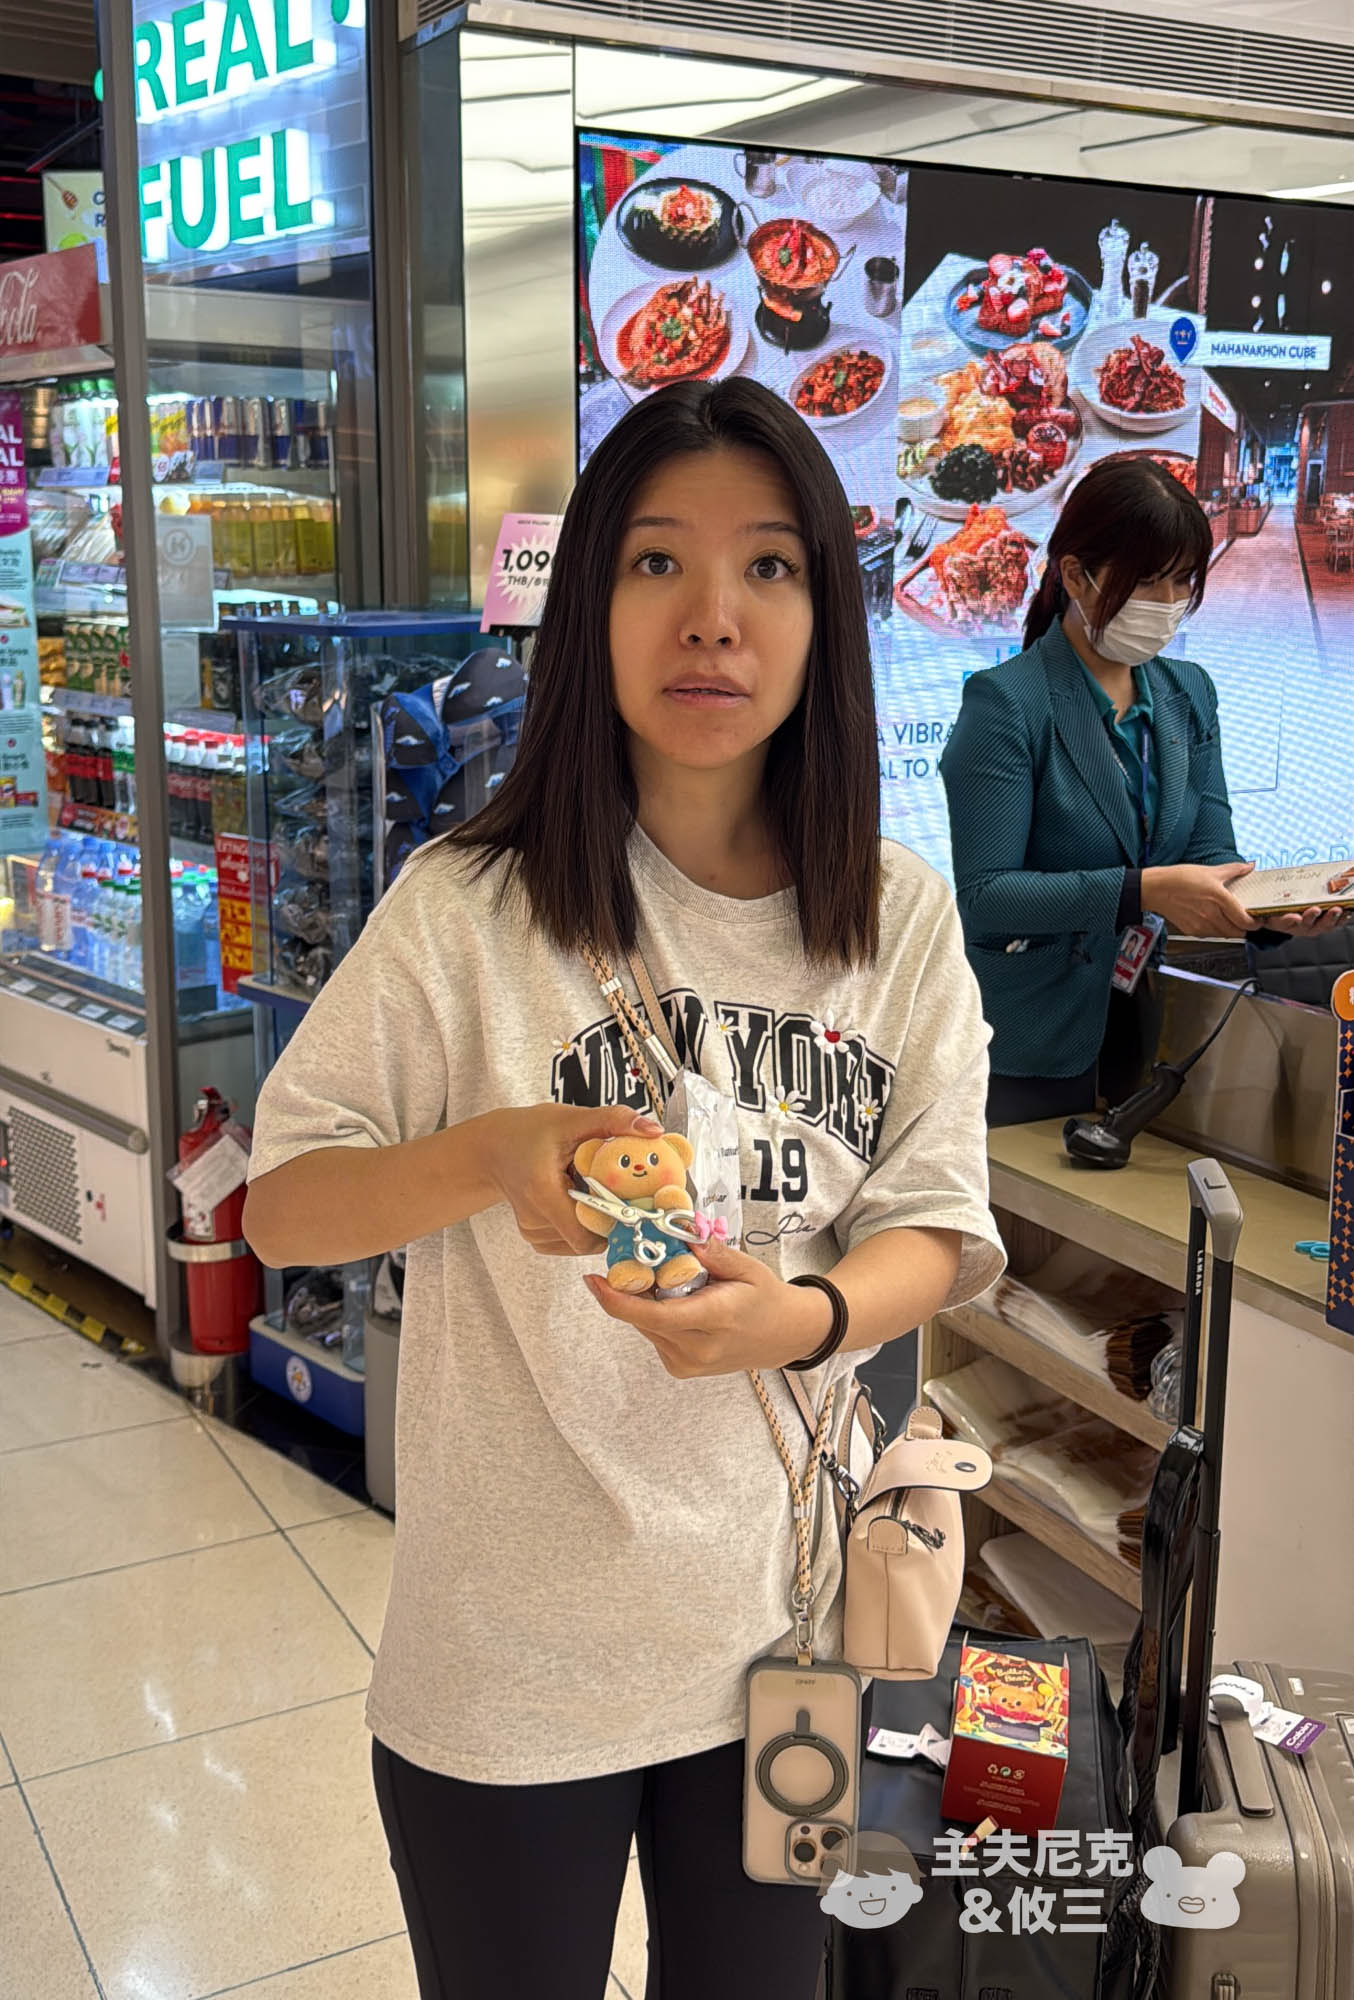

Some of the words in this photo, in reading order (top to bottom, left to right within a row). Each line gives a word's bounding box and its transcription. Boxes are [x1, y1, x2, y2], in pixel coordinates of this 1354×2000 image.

[136, 0, 314, 115] REAL
[140, 128, 312, 258] FUEL
[1211, 343, 1287, 358] MAHANAKHON
[1289, 346, 1316, 359] CUBE
[904, 758, 929, 778] TO
[551, 988, 707, 1116] NEW
[714, 1000, 897, 1165] YORK
